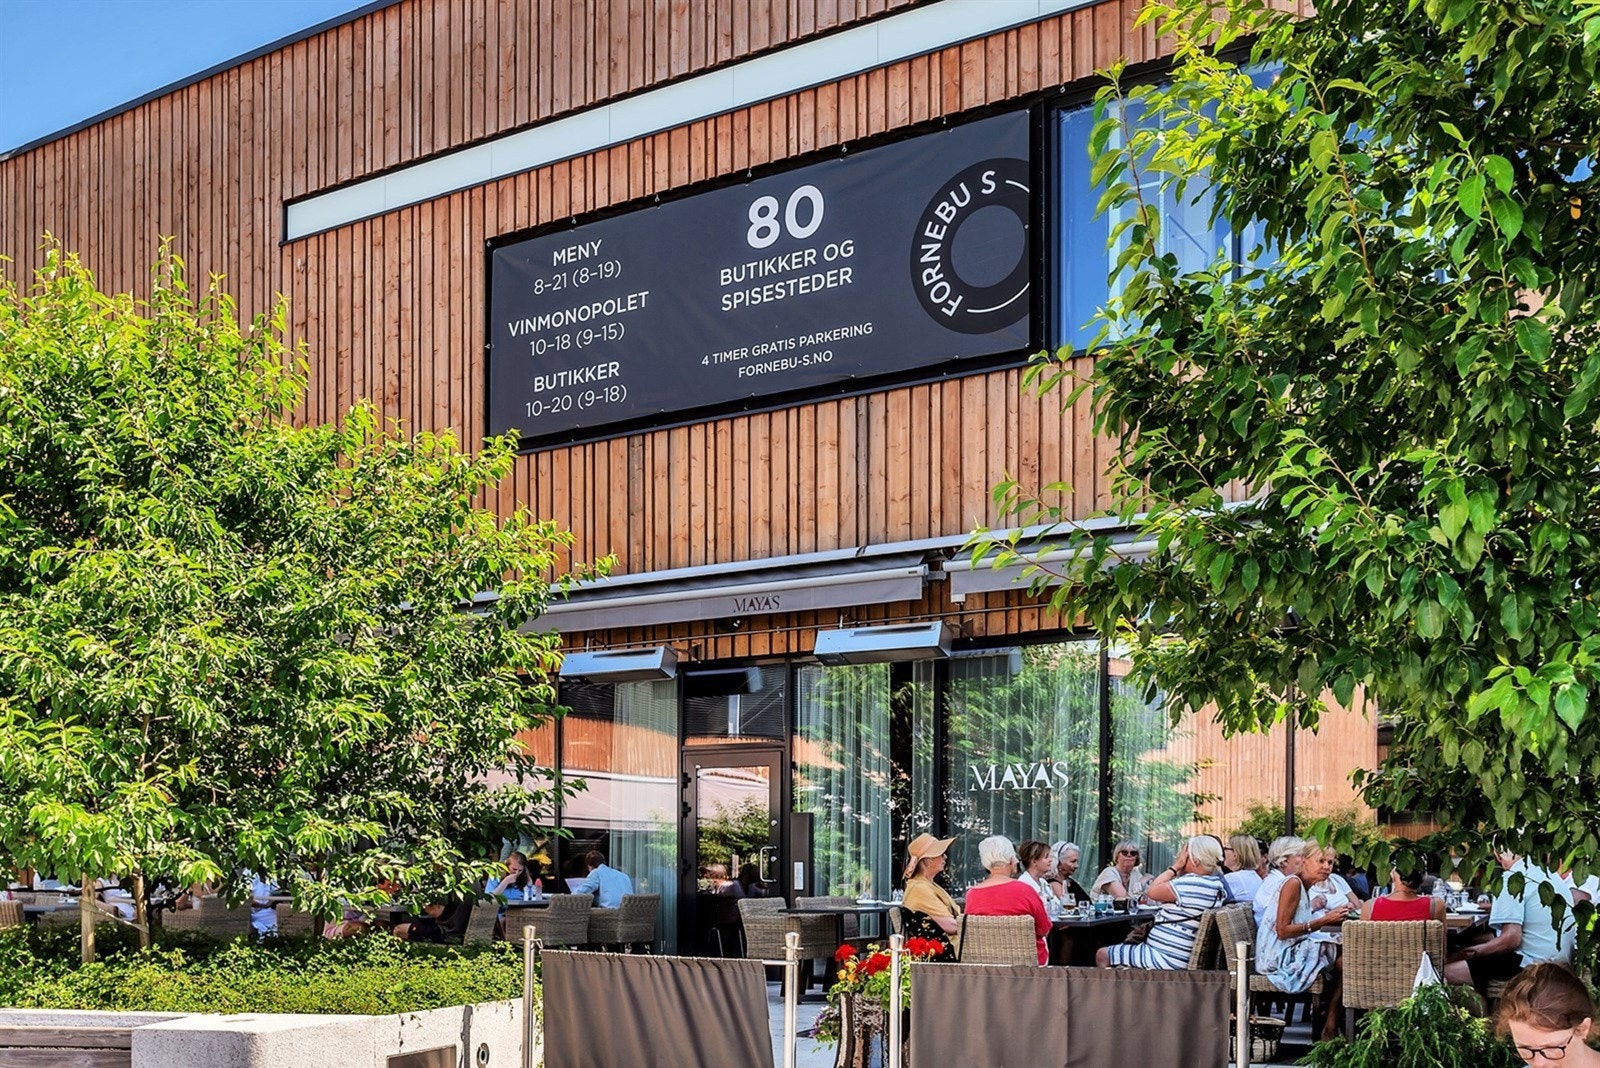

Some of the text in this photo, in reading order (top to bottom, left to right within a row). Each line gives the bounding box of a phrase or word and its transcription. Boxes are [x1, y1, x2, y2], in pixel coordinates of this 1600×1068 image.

[747, 184, 825, 249] 80
[553, 239, 602, 266] MENY
[919, 170, 997, 317] FORNEBU S
[533, 259, 622, 295] 8-21 (8-19)
[720, 239, 855, 287] BUTIKKER OG
[721, 266, 853, 312] SPISESTEDER
[508, 290, 650, 337] VINMONOPOLET
[530, 322, 625, 356] 10-18 (9-15)
[701, 322, 873, 366] 4 TIMER GRATIS PARKERING
[533, 361, 620, 393] BUTIKKER
[738, 350, 833, 379] FORNEBU-S.NO
[525, 384, 627, 417] 10-20 (9-18)
[733, 594, 780, 612] MAYA'S
[969, 758, 1069, 791] MAYA'S
